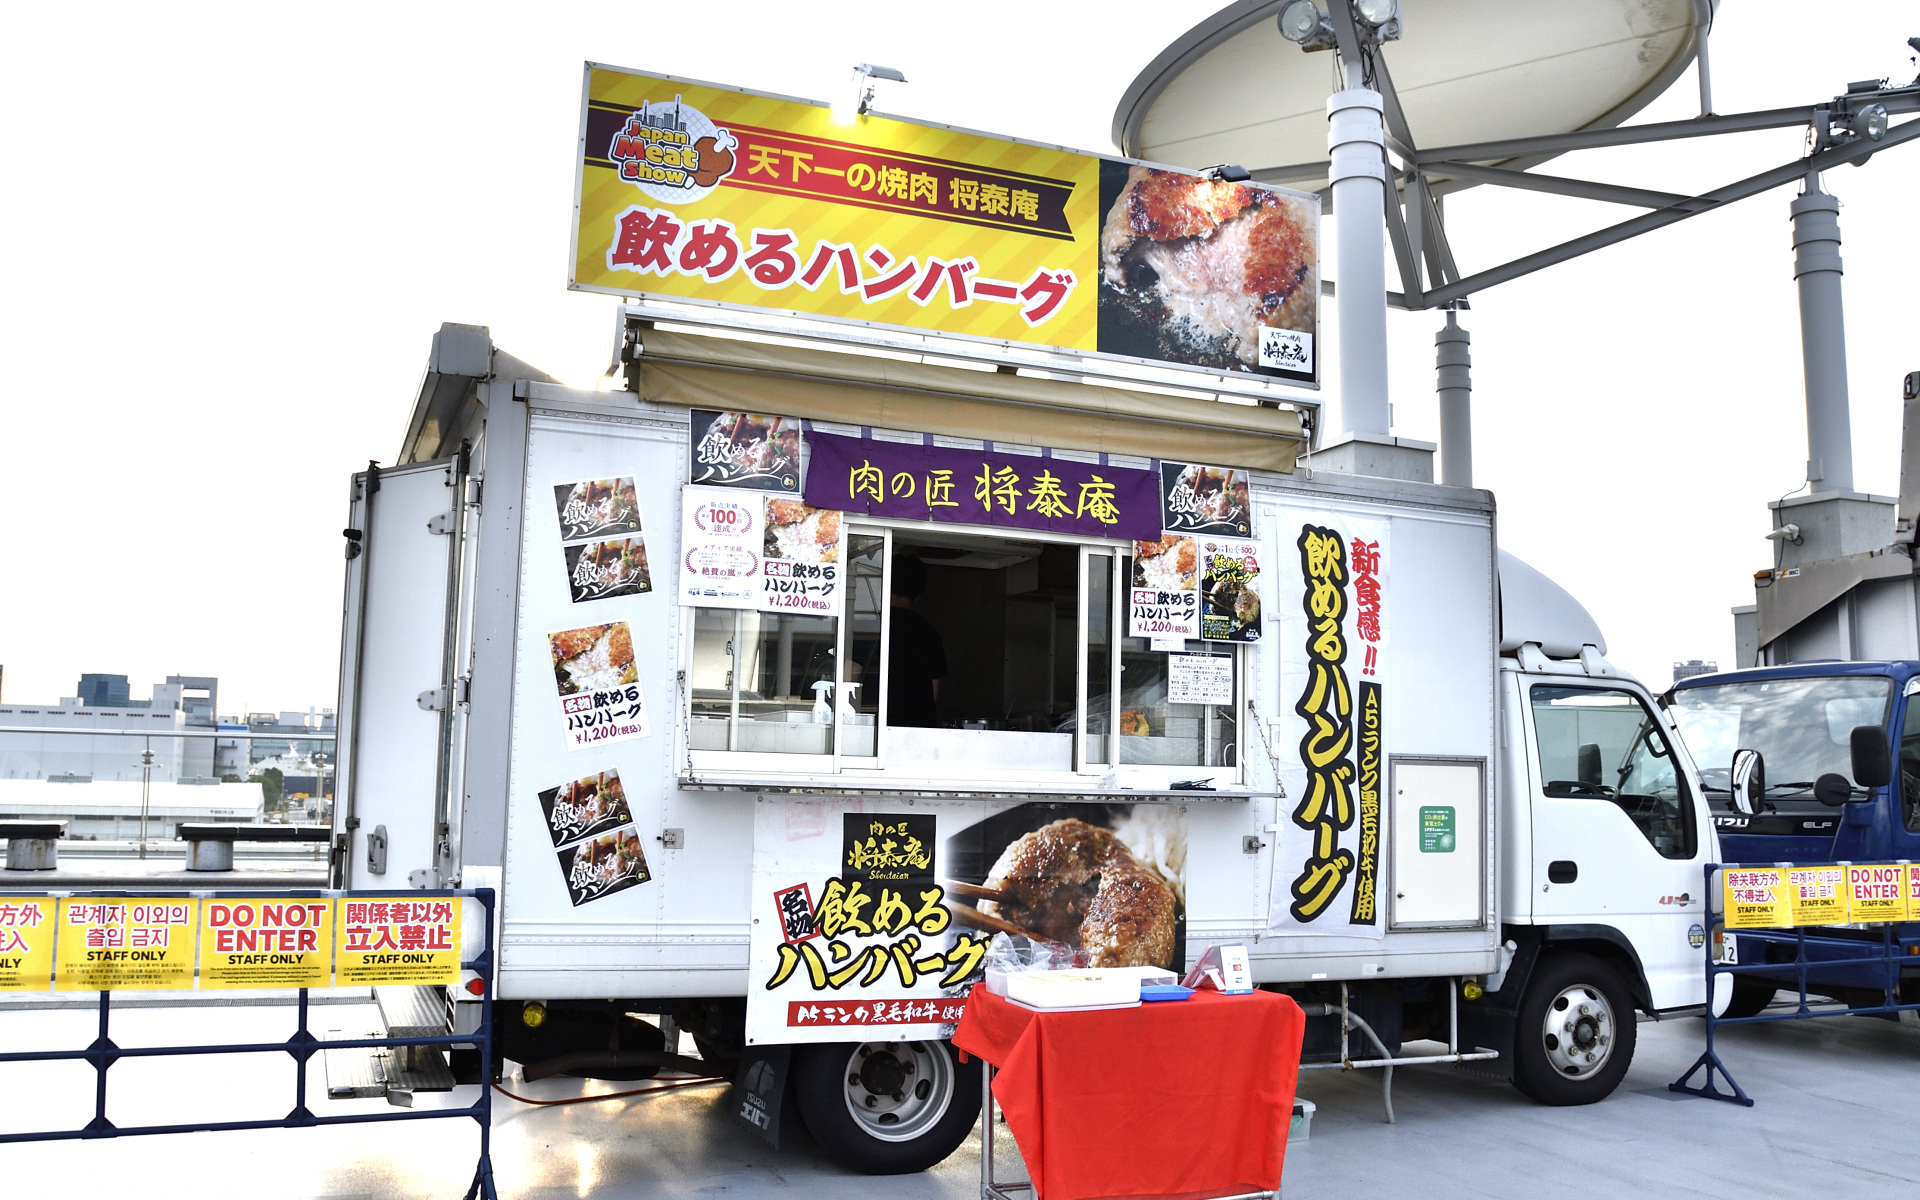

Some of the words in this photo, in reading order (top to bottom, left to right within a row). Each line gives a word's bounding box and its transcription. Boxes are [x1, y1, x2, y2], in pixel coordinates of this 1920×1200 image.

[627, 121, 688, 144] Japan
[614, 136, 698, 170] Meat
[624, 161, 685, 184] Show
[748, 144, 937, 204] 天下一の焼肉
[949, 177, 1039, 221] 将泰庵
[610, 209, 1075, 325] 飲めるハンバーグ
[697, 431, 763, 465] 飲める
[694, 455, 791, 483] ハンバーグ
[849, 459, 959, 508] 肉の匠
[973, 462, 1122, 525] 将泰庵
[1168, 483, 1221, 513] 飲める
[562, 496, 611, 525] 飲める
[709, 508, 736, 525] 100
[1167, 505, 1243, 529] ハンバーグ
[573, 558, 621, 587] 飲める
[792, 562, 836, 580] 飲める
[1213, 554, 1245, 570] 飲める
[1204, 568, 1258, 584] ハンバーグ
[764, 578, 836, 596] ハンバーグ
[1157, 591, 1196, 606] 飲める
[1134, 606, 1196, 621] ハンバーグ
[593, 685, 640, 709] 飲める
[568, 702, 642, 731] ハンバーグ
[1294, 527, 1354, 920] 飲めるハンバーグ
[550, 793, 598, 831] 飲める
[869, 820, 909, 837] 肉の匠
[1803, 821, 1833, 829] ELF
[847, 836, 932, 871] 将泰庵
[569, 852, 617, 890] 飲める
[1728, 872, 1780, 887] 除关联方外
[1790, 871, 1816, 884] 관계자
[1818, 870, 1842, 882] 이외의
[1851, 869, 1870, 883] DO
[1873, 868, 1901, 883] NOT
[1734, 888, 1776, 903] 不得进入
[1799, 886, 1816, 898] 출입
[1819, 885, 1835, 897] 금지
[1855, 884, 1899, 898] ENTER
[69, 905, 126, 924] 관계자
[133, 905, 189, 925] 이외의
[210, 905, 250, 927] DO
[262, 905, 326, 927] NOT
[346, 903, 453, 924] 関係者以外
[782, 889, 815, 939] 名物
[812, 878, 951, 940] 飲める
[1757, 905, 1774, 913] ONLY
[87, 928, 123, 947] 출입
[131, 928, 169, 947] 금지
[216, 930, 318, 952] ENTER
[345, 925, 452, 951] 立入禁止
[87, 951, 129, 961] STAFF
[131, 951, 167, 961] ONLY
[228, 955, 268, 965] STAFF
[270, 954, 304, 964] ONLY
[362, 954, 400, 964] STAFF
[401, 953, 435, 964] ONLY
[766, 934, 993, 990] ハンバーグ
[746, 1091, 766, 1110] ISUZU
